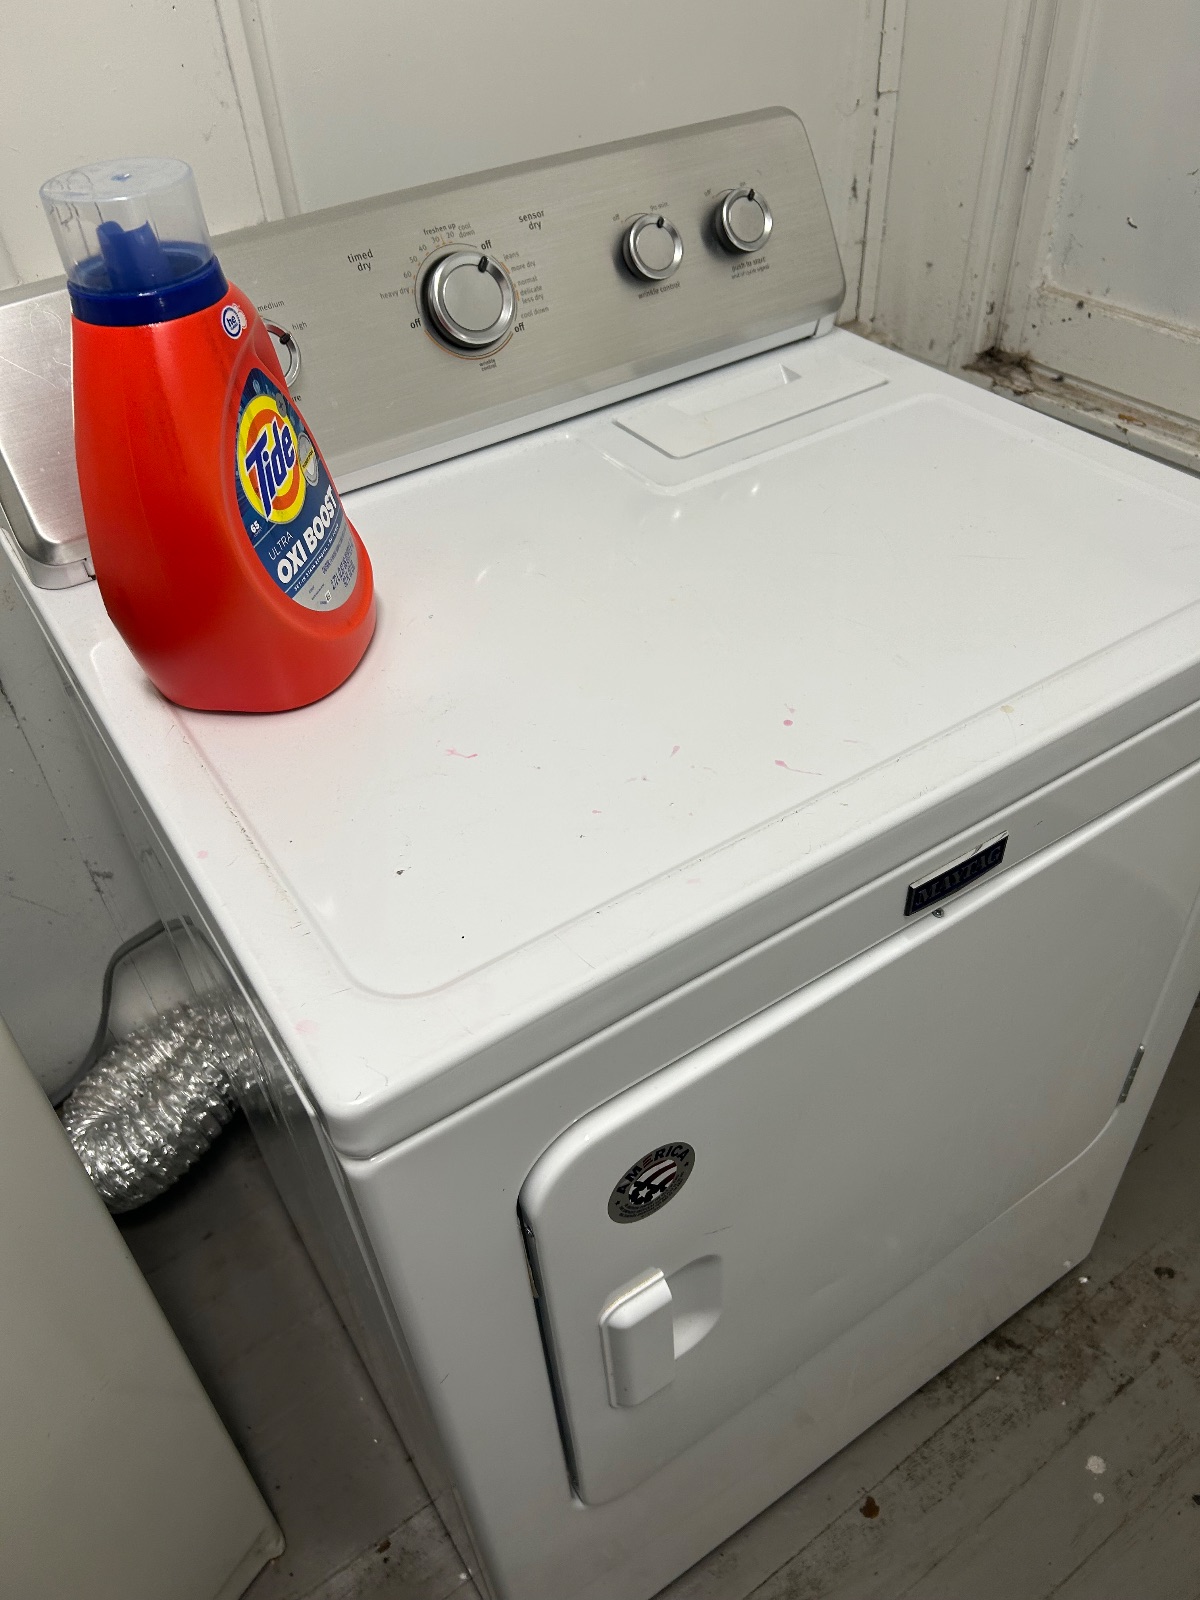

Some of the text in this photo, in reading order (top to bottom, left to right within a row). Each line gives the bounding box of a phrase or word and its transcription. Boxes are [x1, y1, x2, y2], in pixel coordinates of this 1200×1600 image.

[518, 210, 545, 223] sensor
[423, 223, 456, 236] freshen up
[458, 222, 471, 231] cool
[528, 221, 542, 231] dry
[431, 236, 440, 244] 30
[446, 231, 455, 239] 20
[459, 230, 475, 239] down
[418, 244, 427, 252] 40
[480, 240, 492, 250] off
[347, 249, 374, 263] timed
[409, 256, 418, 264] 50
[503, 251, 520, 261] jeans
[357, 262, 372, 272] dry
[511, 260, 536, 273] more dry
[403, 271, 412, 279] 60
[517, 275, 538, 286] normal
[379, 287, 410, 300] heavy dry
[520, 285, 542, 296] delicate
[638, 281, 681, 300] wrinkle control
[522, 293, 544, 304] less dry
[257, 300, 285, 312] medium
[521, 306, 549, 319] cool down
[226, 315, 237, 328] he
[291, 321, 308, 332] high
[410, 317, 422, 329] off
[514, 322, 525, 333] off
[245, 418, 295, 520] Tide
[250, 520, 260, 534] 65
[277, 539, 308, 583] OXI
[303, 484, 337, 554] BOOST
[268, 531, 294, 560] ULTRA
[914, 844, 1002, 905] MAYTAG
[616, 1144, 690, 1194] AMERICA
